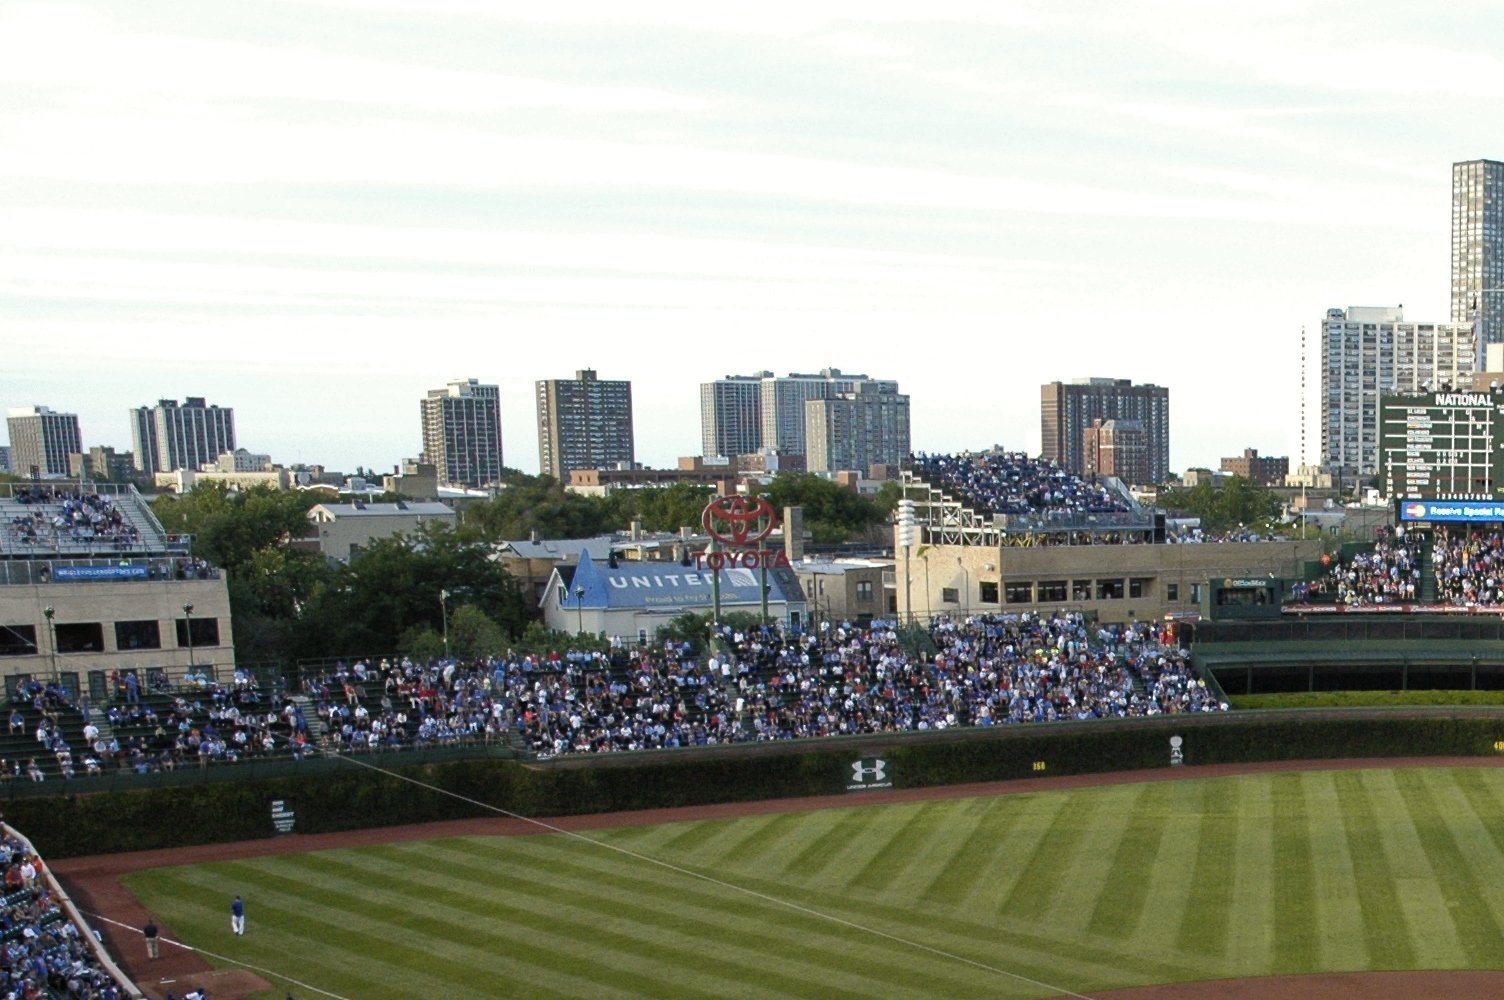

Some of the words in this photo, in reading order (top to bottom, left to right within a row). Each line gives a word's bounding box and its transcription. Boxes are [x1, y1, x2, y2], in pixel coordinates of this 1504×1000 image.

[1435, 393, 1494, 406] NATIONAL
[1430, 506, 1462, 516] Receive
[1463, 507, 1493, 518] Special
[691, 549, 791, 571] TOYOTA
[609, 573, 722, 589] UNITED
